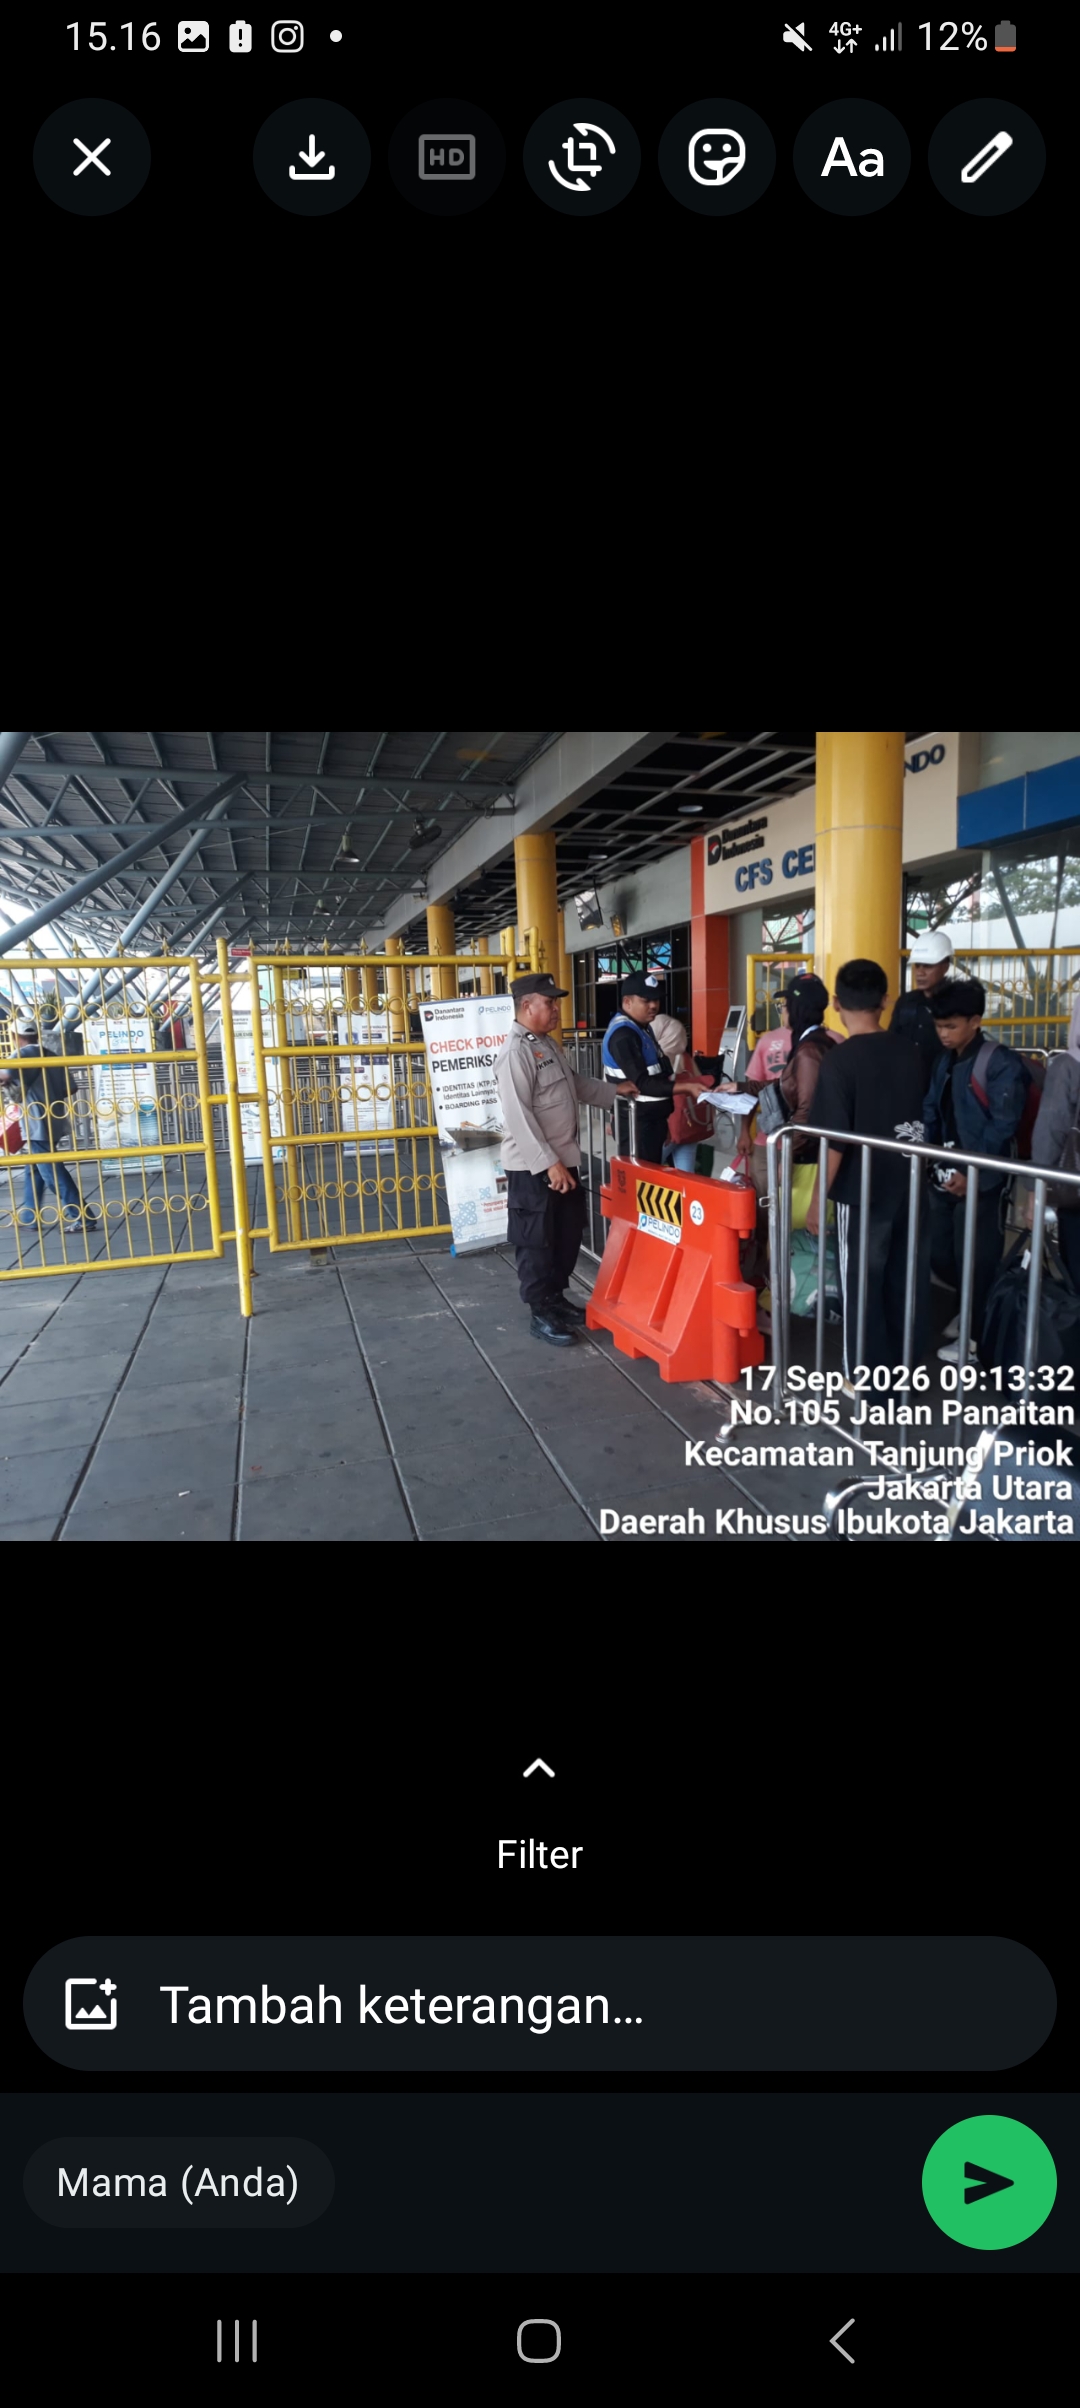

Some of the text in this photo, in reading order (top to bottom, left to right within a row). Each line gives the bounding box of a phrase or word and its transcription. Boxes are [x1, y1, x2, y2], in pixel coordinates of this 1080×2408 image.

[735, 843, 816, 893] CFS CE
[434, 1006, 465, 1015] Danantara
[485, 1005, 511, 1013] PELINDO
[435, 1013, 464, 1021] Indonesia
[430, 1037, 474, 1054] CHECK
[442, 1080, 499, 1093] IDENTITAS (KTP/S
[443, 1091, 470, 1101] Identitas
[445, 1100, 480, 1110] BOARDING
[692, 1206, 703, 1221] 23
[648, 1217, 680, 1239] PELINDO
